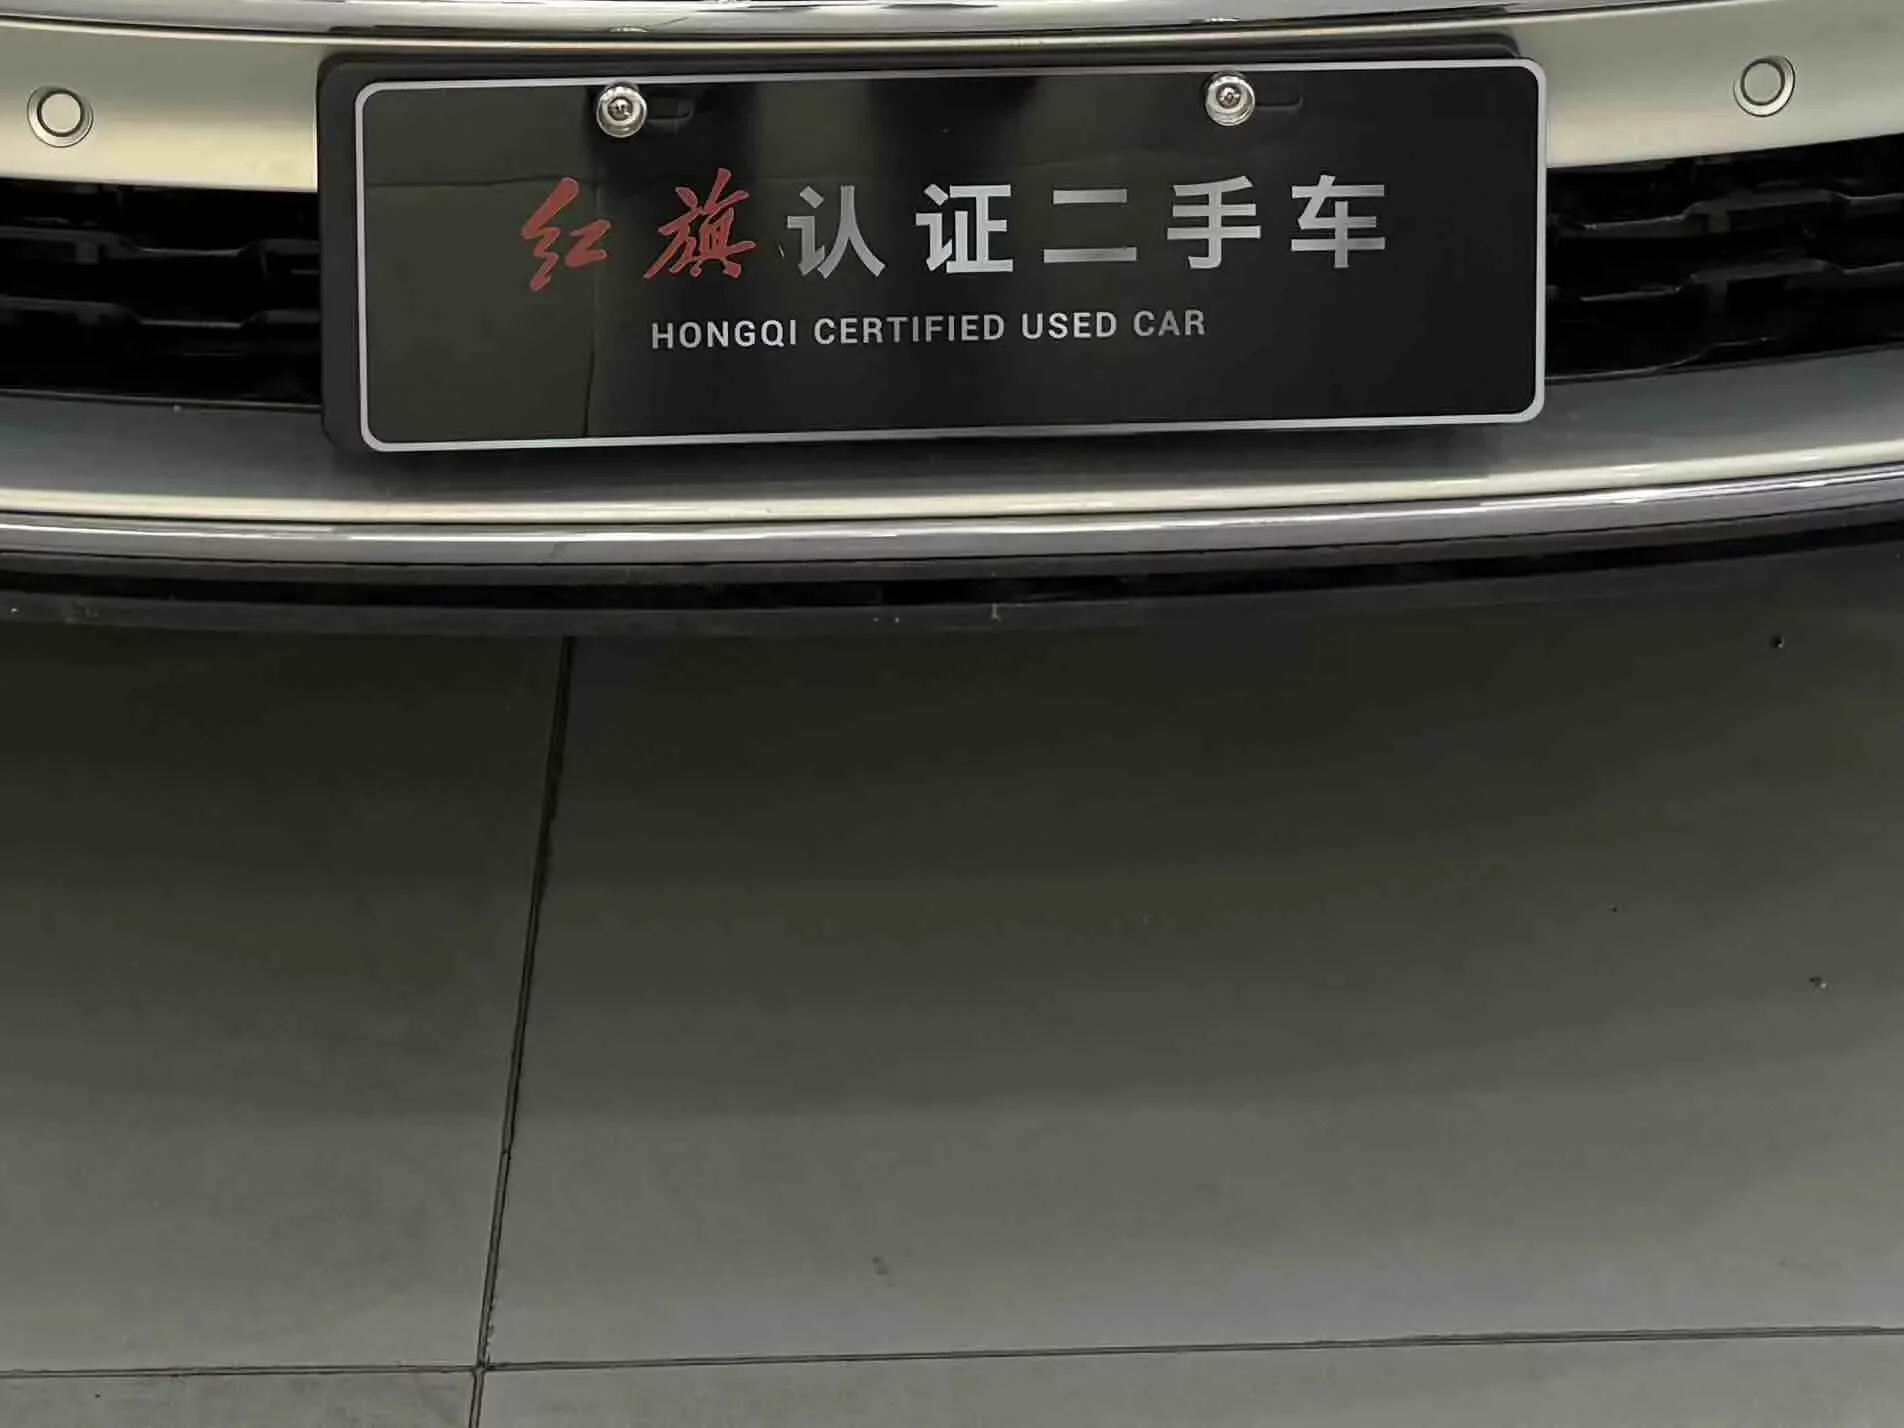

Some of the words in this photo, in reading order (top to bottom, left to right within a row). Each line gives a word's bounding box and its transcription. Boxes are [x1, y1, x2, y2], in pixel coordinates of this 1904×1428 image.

[521, 168, 1388, 293] 红旗认证二手车
[650, 318, 800, 350] HONGQI
[814, 313, 1005, 346] CERTIFIED
[1020, 312, 1117, 341] USED
[1132, 308, 1207, 338] CAR
